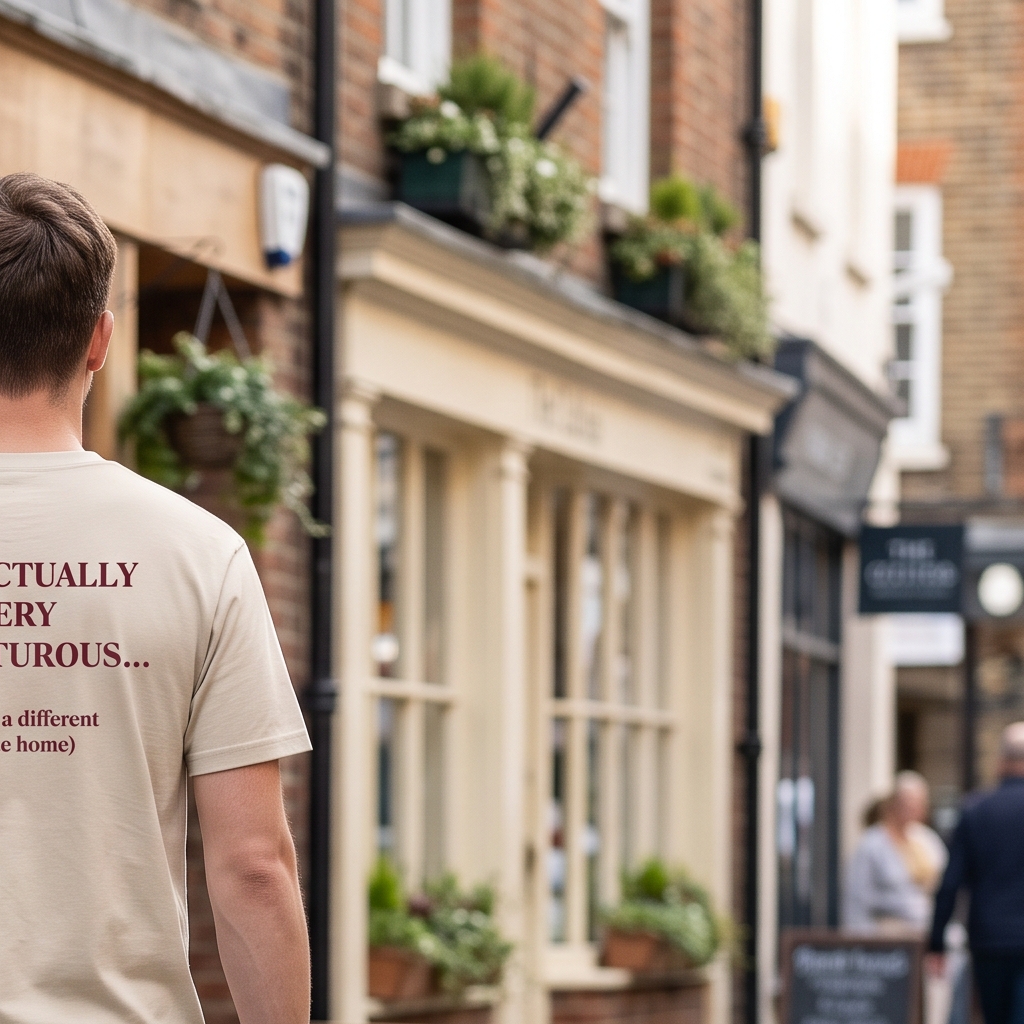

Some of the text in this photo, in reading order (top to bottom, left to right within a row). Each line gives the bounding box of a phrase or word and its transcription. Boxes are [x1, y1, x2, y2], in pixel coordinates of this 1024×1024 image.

[1, 714, 13, 727] a
[17, 709, 99, 727] different
[16, 735, 76, 756] home)
